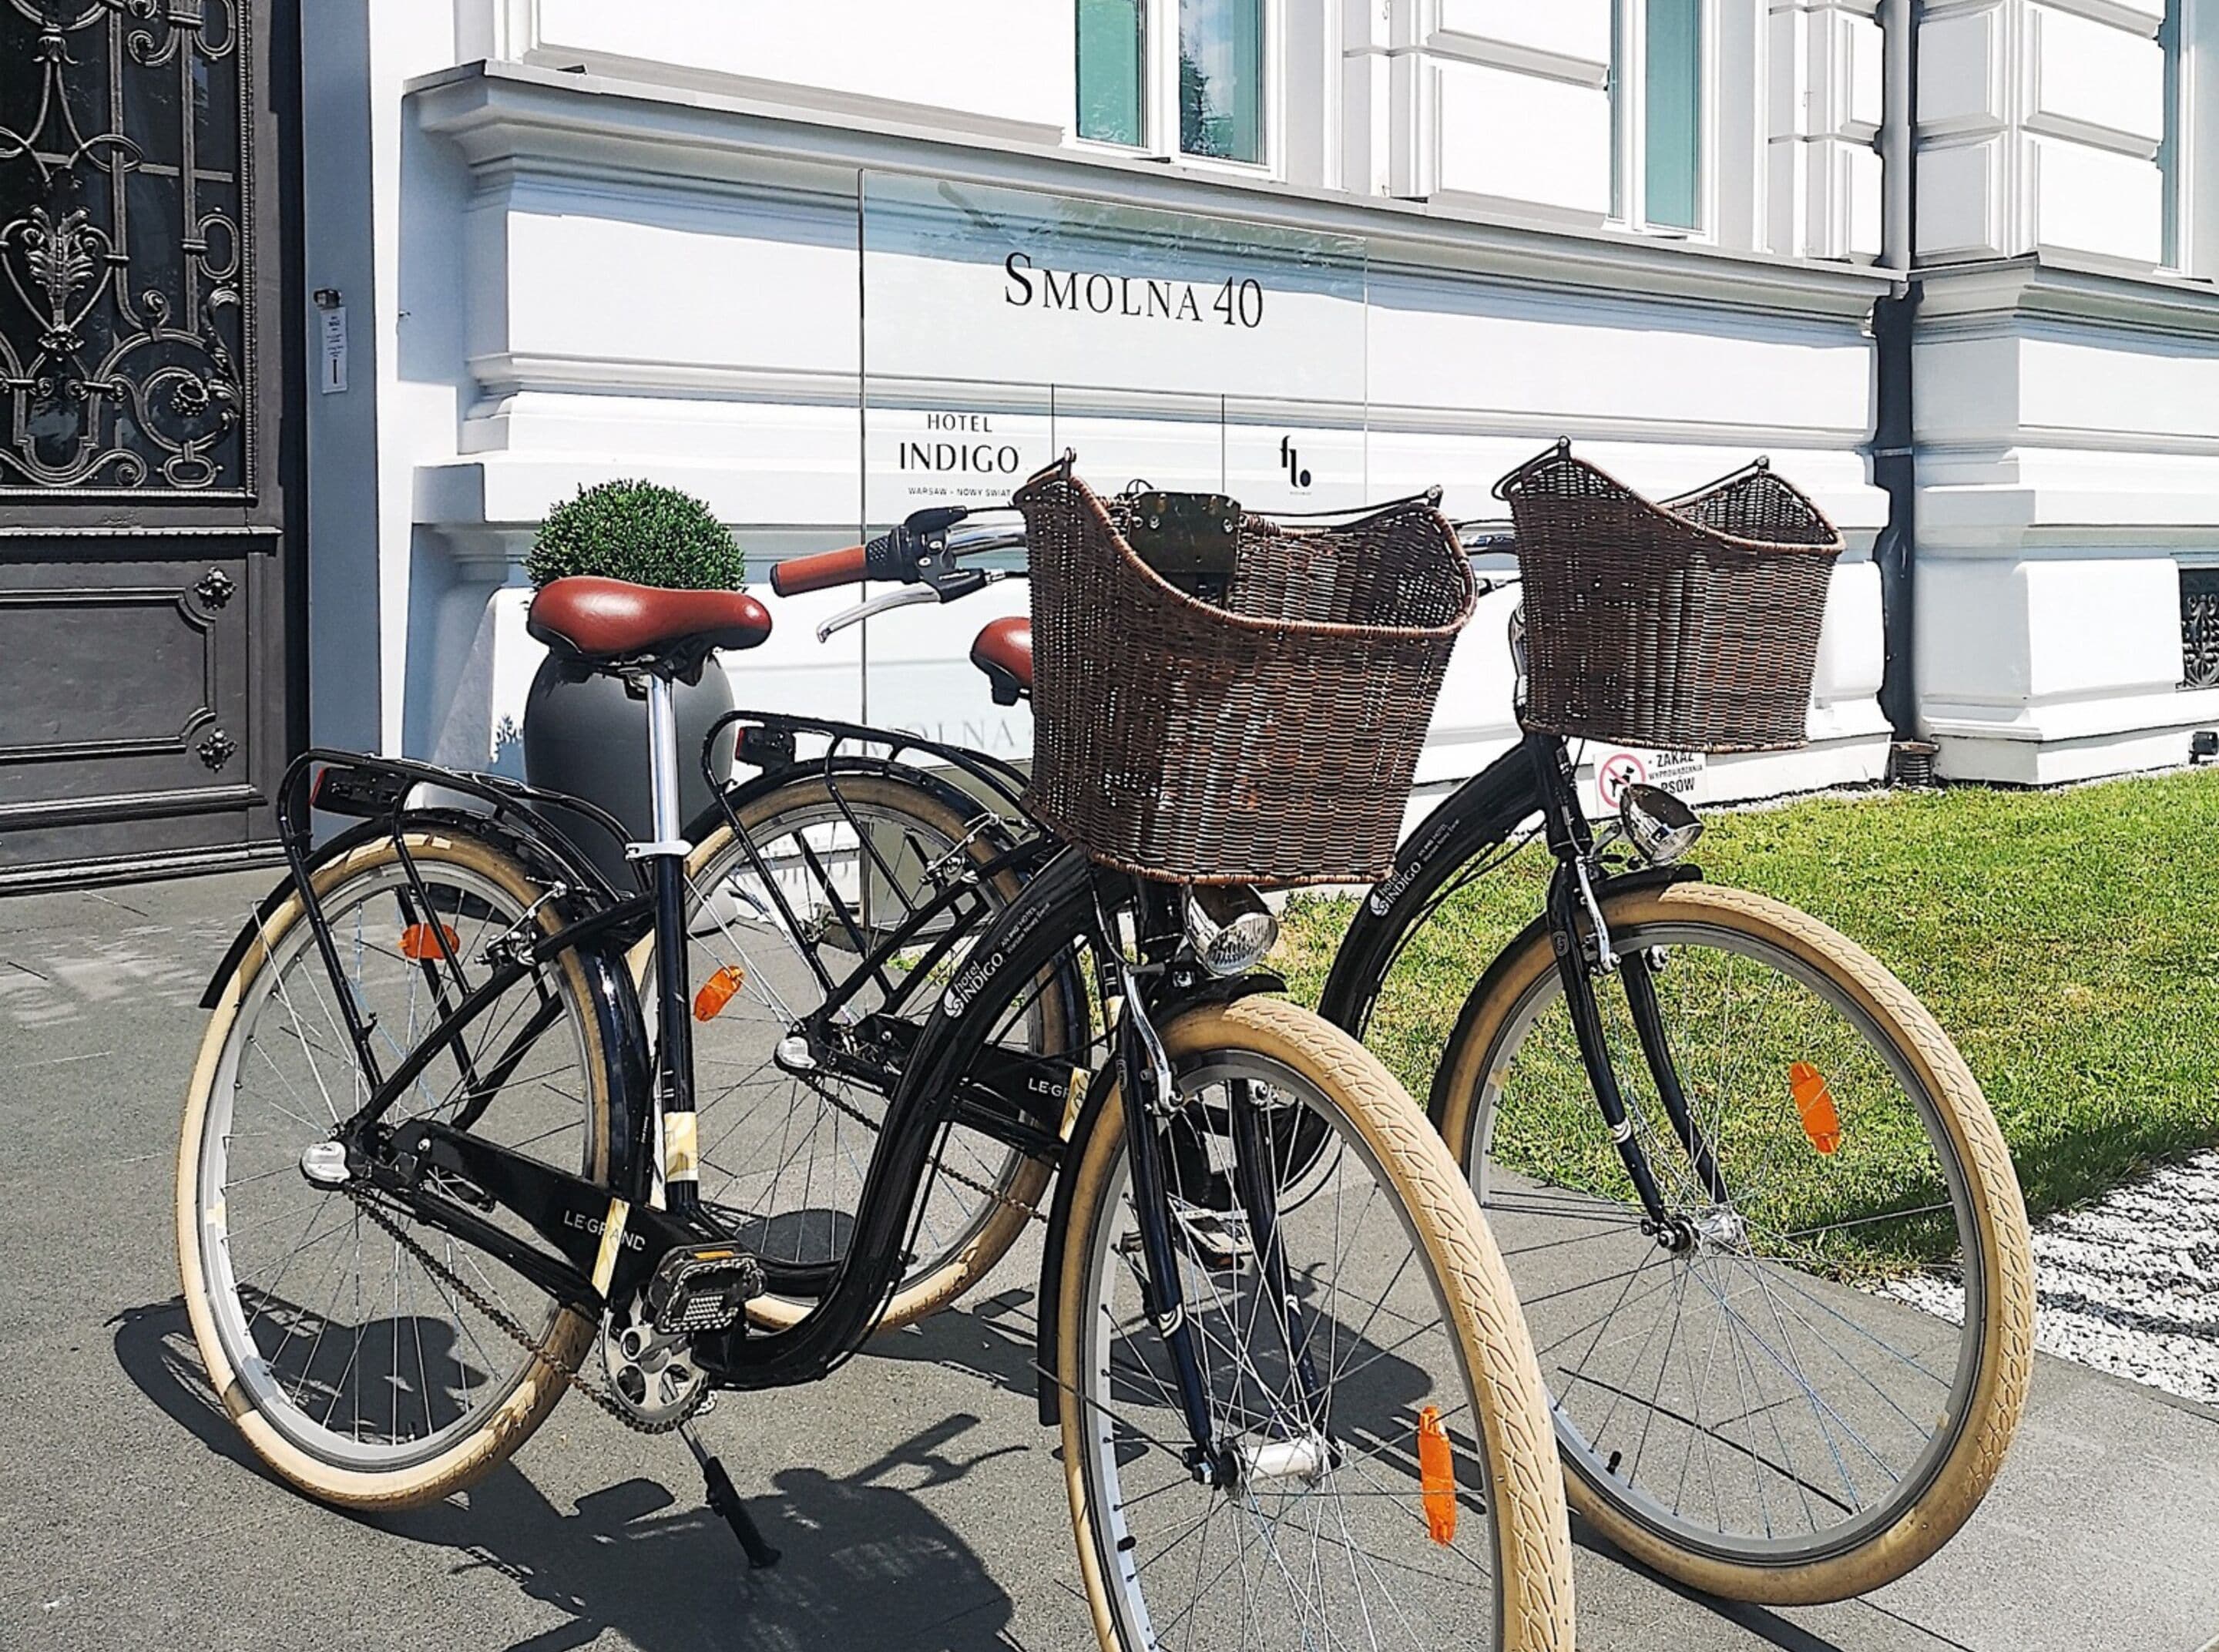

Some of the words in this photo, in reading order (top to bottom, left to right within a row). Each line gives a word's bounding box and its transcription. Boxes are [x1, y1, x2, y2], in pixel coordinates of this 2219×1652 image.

[1005, 252, 1203, 322] SMOLNA
[1214, 276, 1264, 328] 40
[928, 413, 993, 433] HOTEL
[900, 442, 1019, 474] INDIGO
[908, 487, 948, 496] WARSAW
[956, 487, 983, 497] NOWY
[1385, 861, 1422, 905] INDIGO
[953, 960, 980, 993] hotel
[960, 952, 1003, 1004] INDIGO
